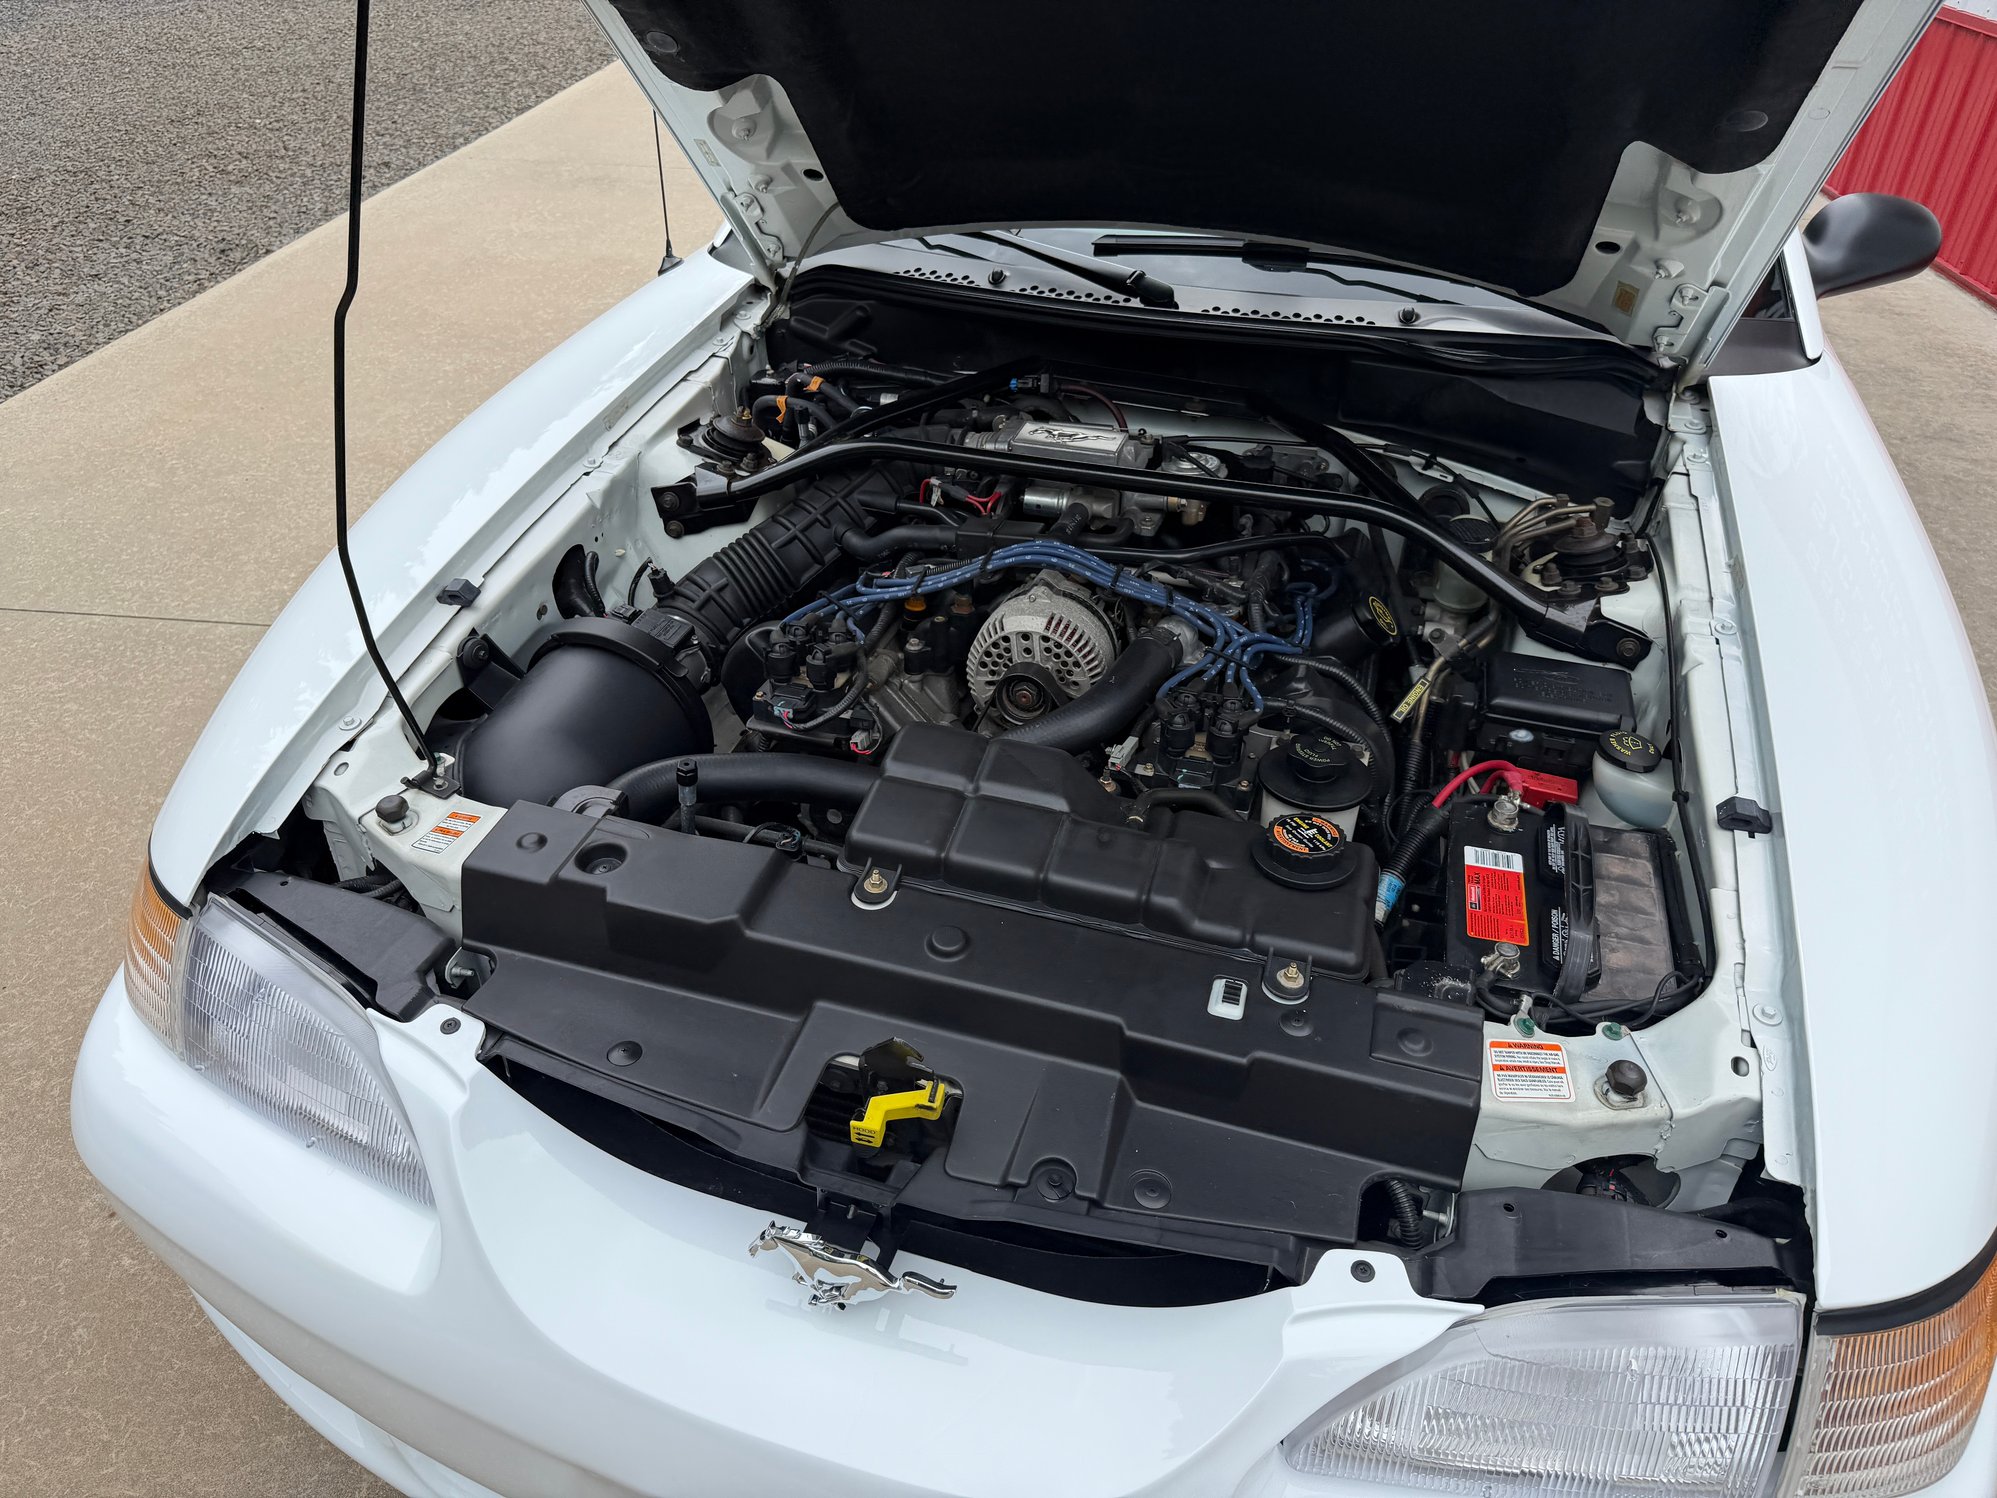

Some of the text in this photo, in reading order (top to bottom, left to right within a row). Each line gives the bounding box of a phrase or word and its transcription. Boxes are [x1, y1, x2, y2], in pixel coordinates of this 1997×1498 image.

[1407, 684, 1424, 704] ENGINE
[1551, 908, 1559, 929] POISON
[1551, 933, 1560, 956] DANGER
[1512, 1042, 1544, 1050] WARNING
[1505, 1064, 1558, 1073] AVERTISSEMENT
